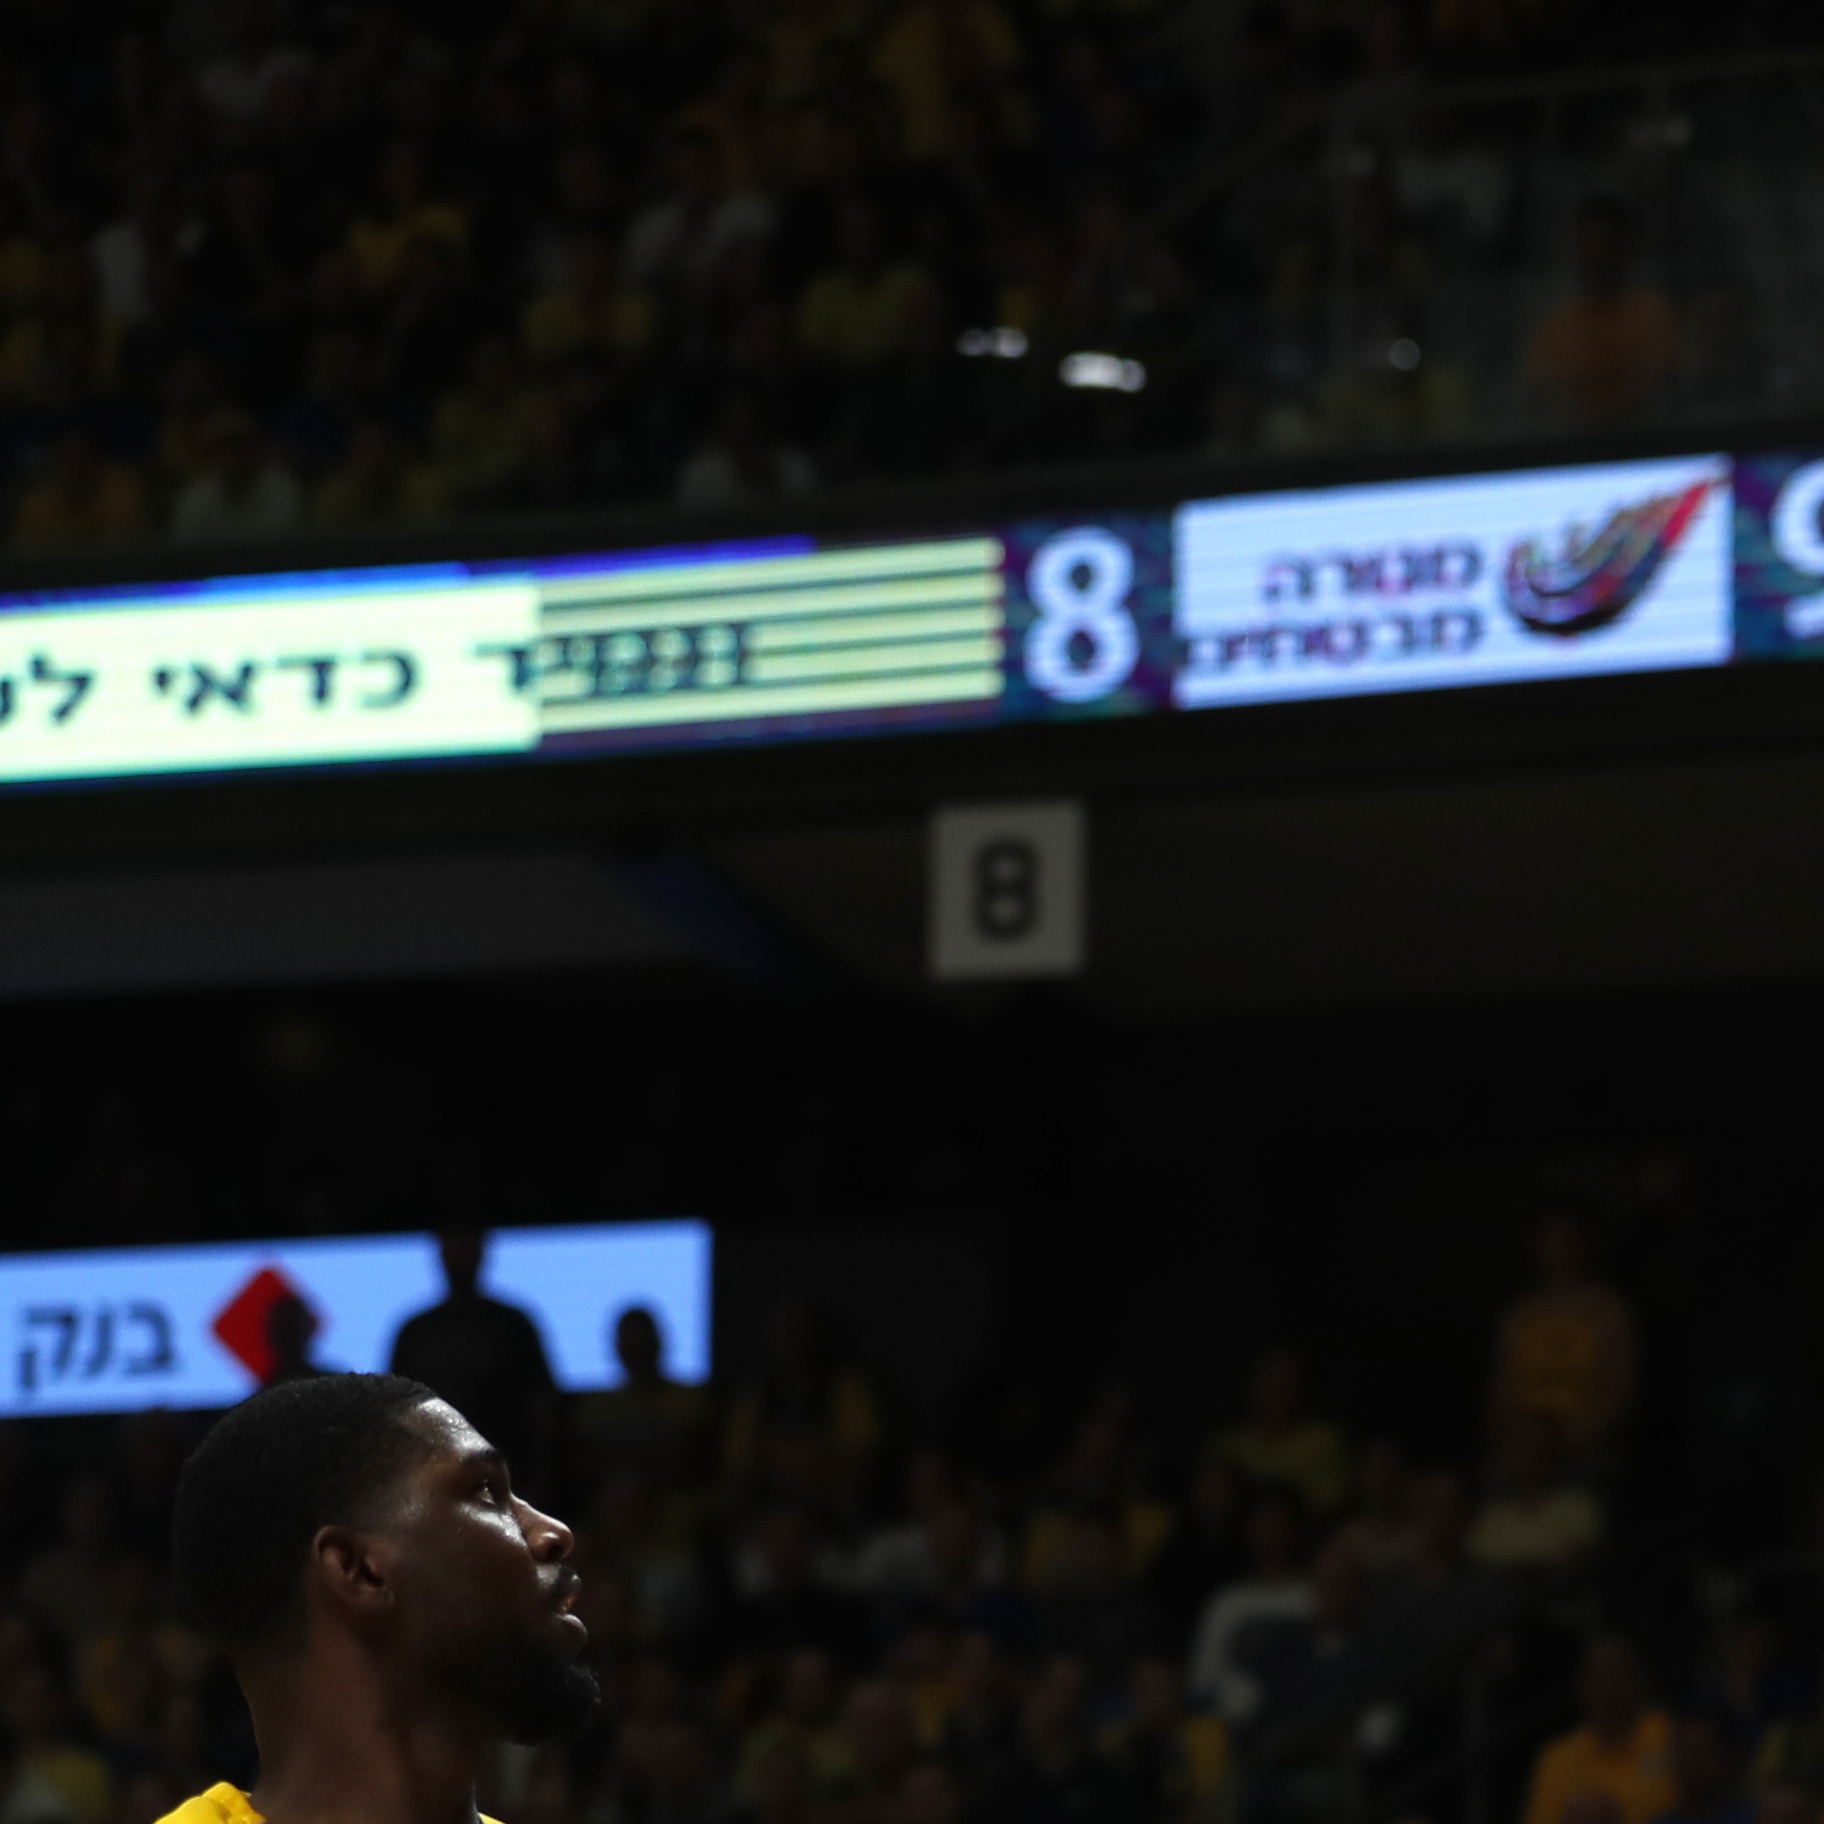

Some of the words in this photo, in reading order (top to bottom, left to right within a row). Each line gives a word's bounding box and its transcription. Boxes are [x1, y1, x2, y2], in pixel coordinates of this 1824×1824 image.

[1025, 527, 1138, 703] 8
[152, 648, 420, 716] כדאי
[974, 836, 1042, 941] 8
[19, 1305, 181, 1391] בנק
